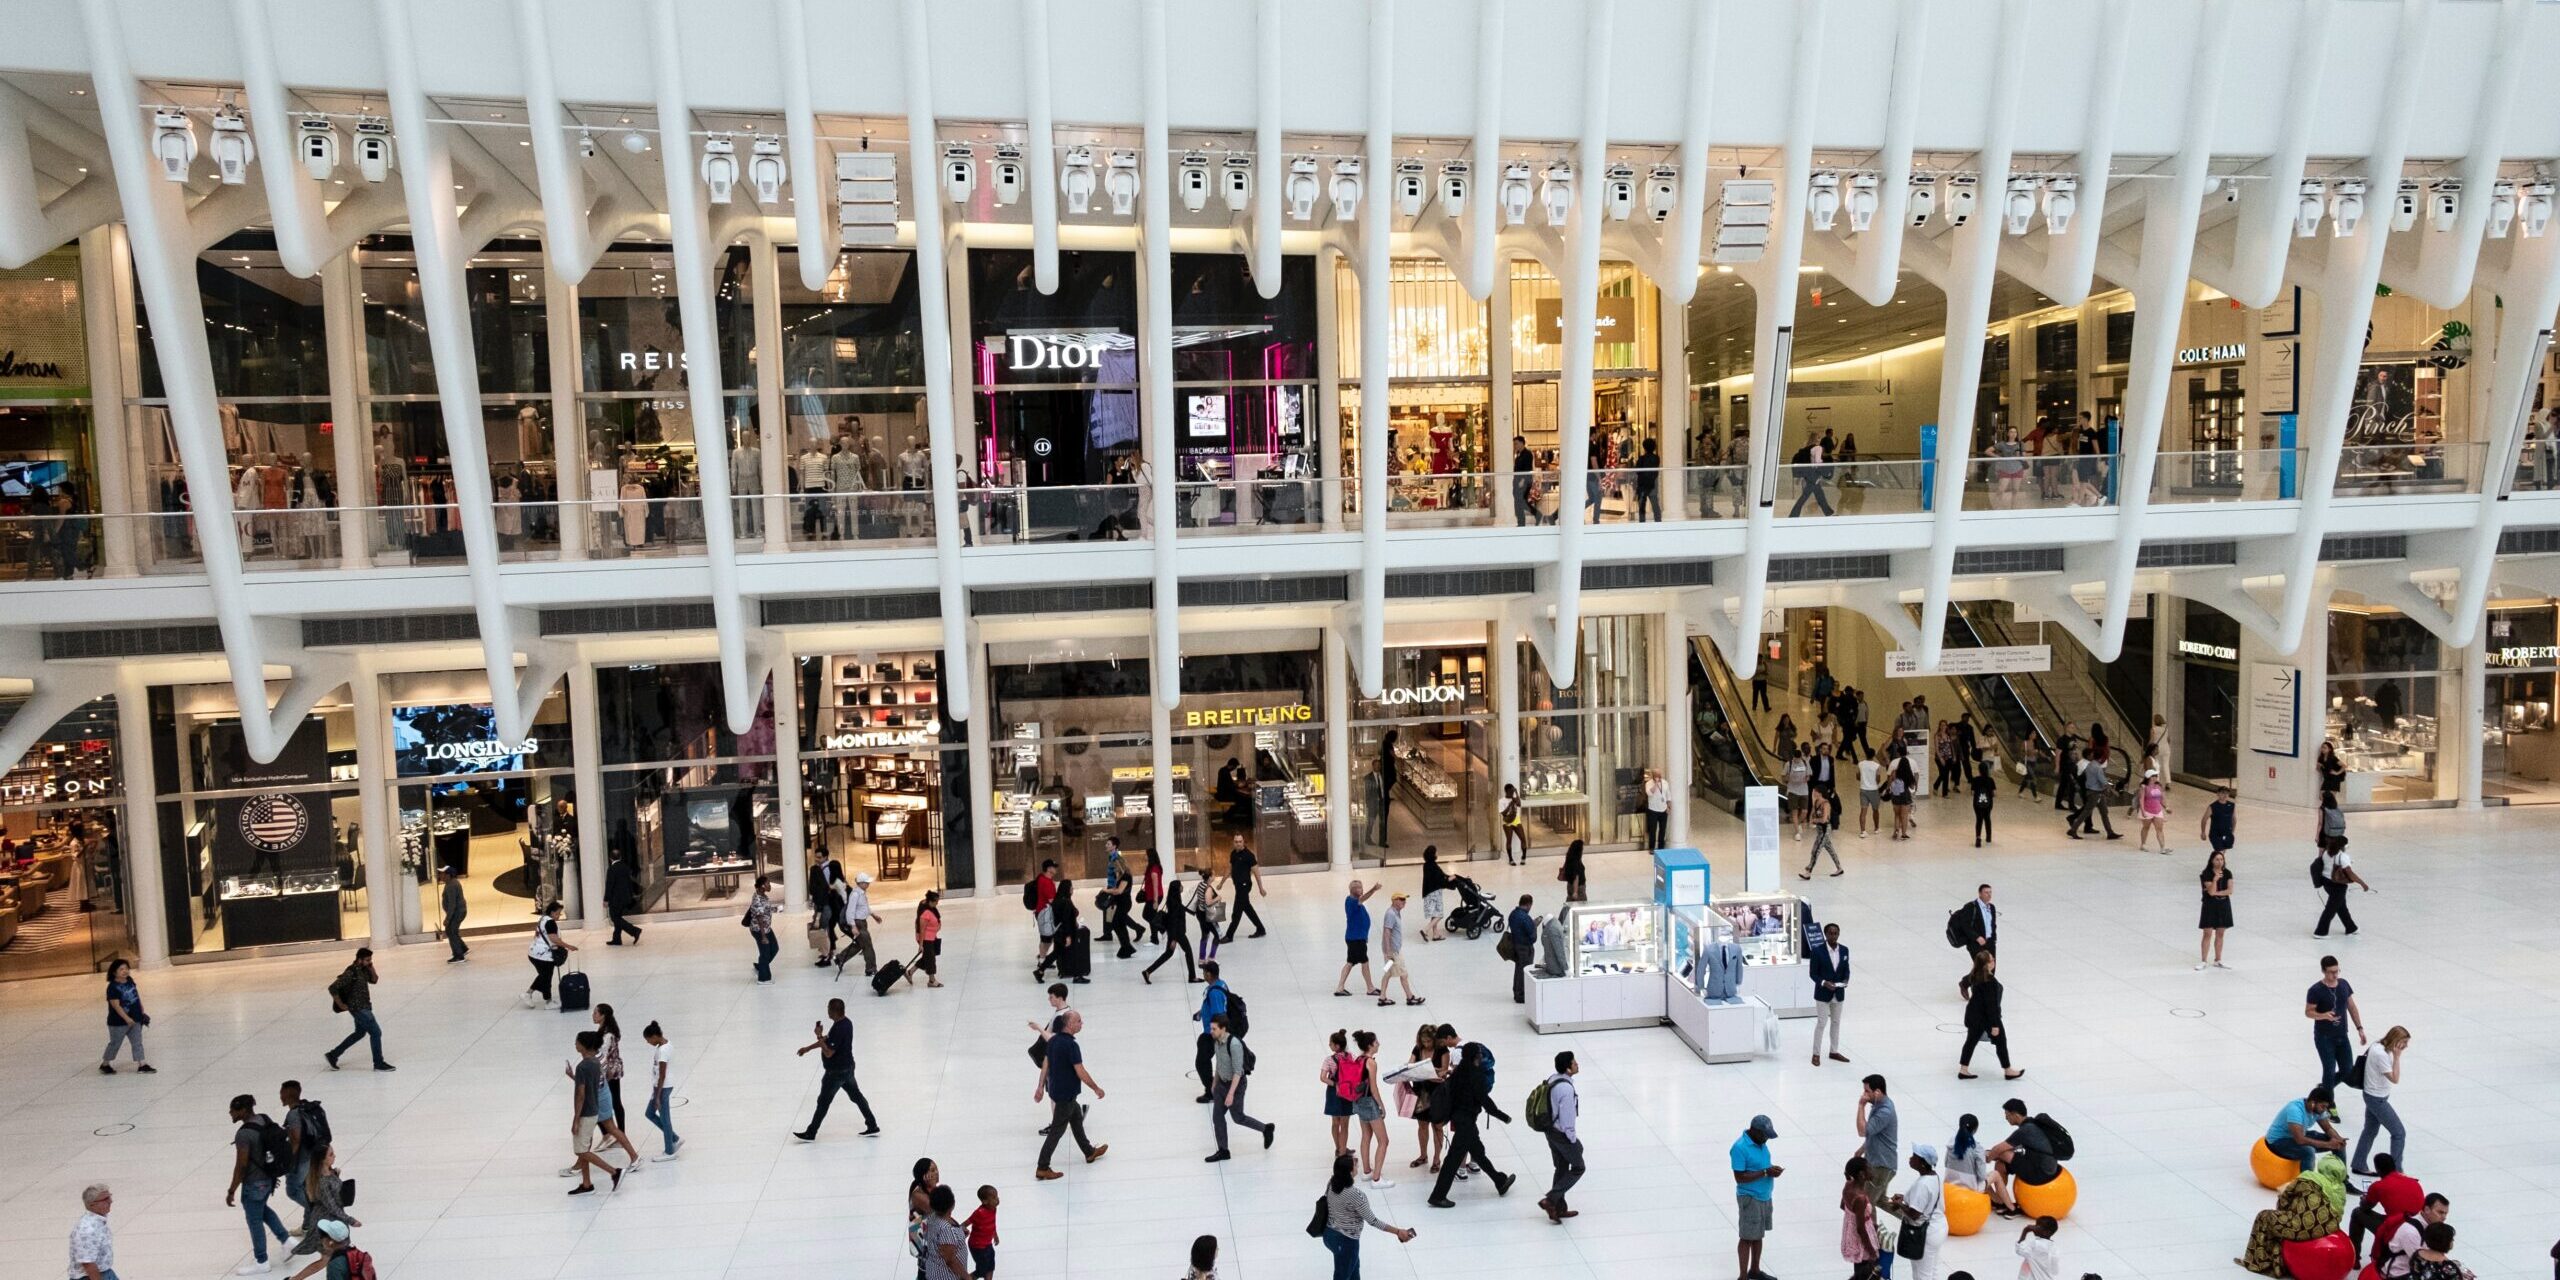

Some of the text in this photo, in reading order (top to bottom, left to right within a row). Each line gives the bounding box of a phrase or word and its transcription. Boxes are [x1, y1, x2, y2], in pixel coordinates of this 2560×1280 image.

[1009, 334, 1108, 369] Dior
[2180, 344, 2246, 362] COLE HAAN
[641, 401, 685, 410] REISS
[2347, 402, 2415, 442] Pinch
[822, 468, 928, 492] SALE
[2180, 640, 2237, 659] ROBERTO COIN
[1382, 685, 1464, 704] LONDON
[1187, 705, 1312, 726] BREITLING
[827, 730, 928, 749] MONTBLANC
[241, 806, 262, 847] EDITION
[271, 803, 306, 850] EXCLUSIVE
